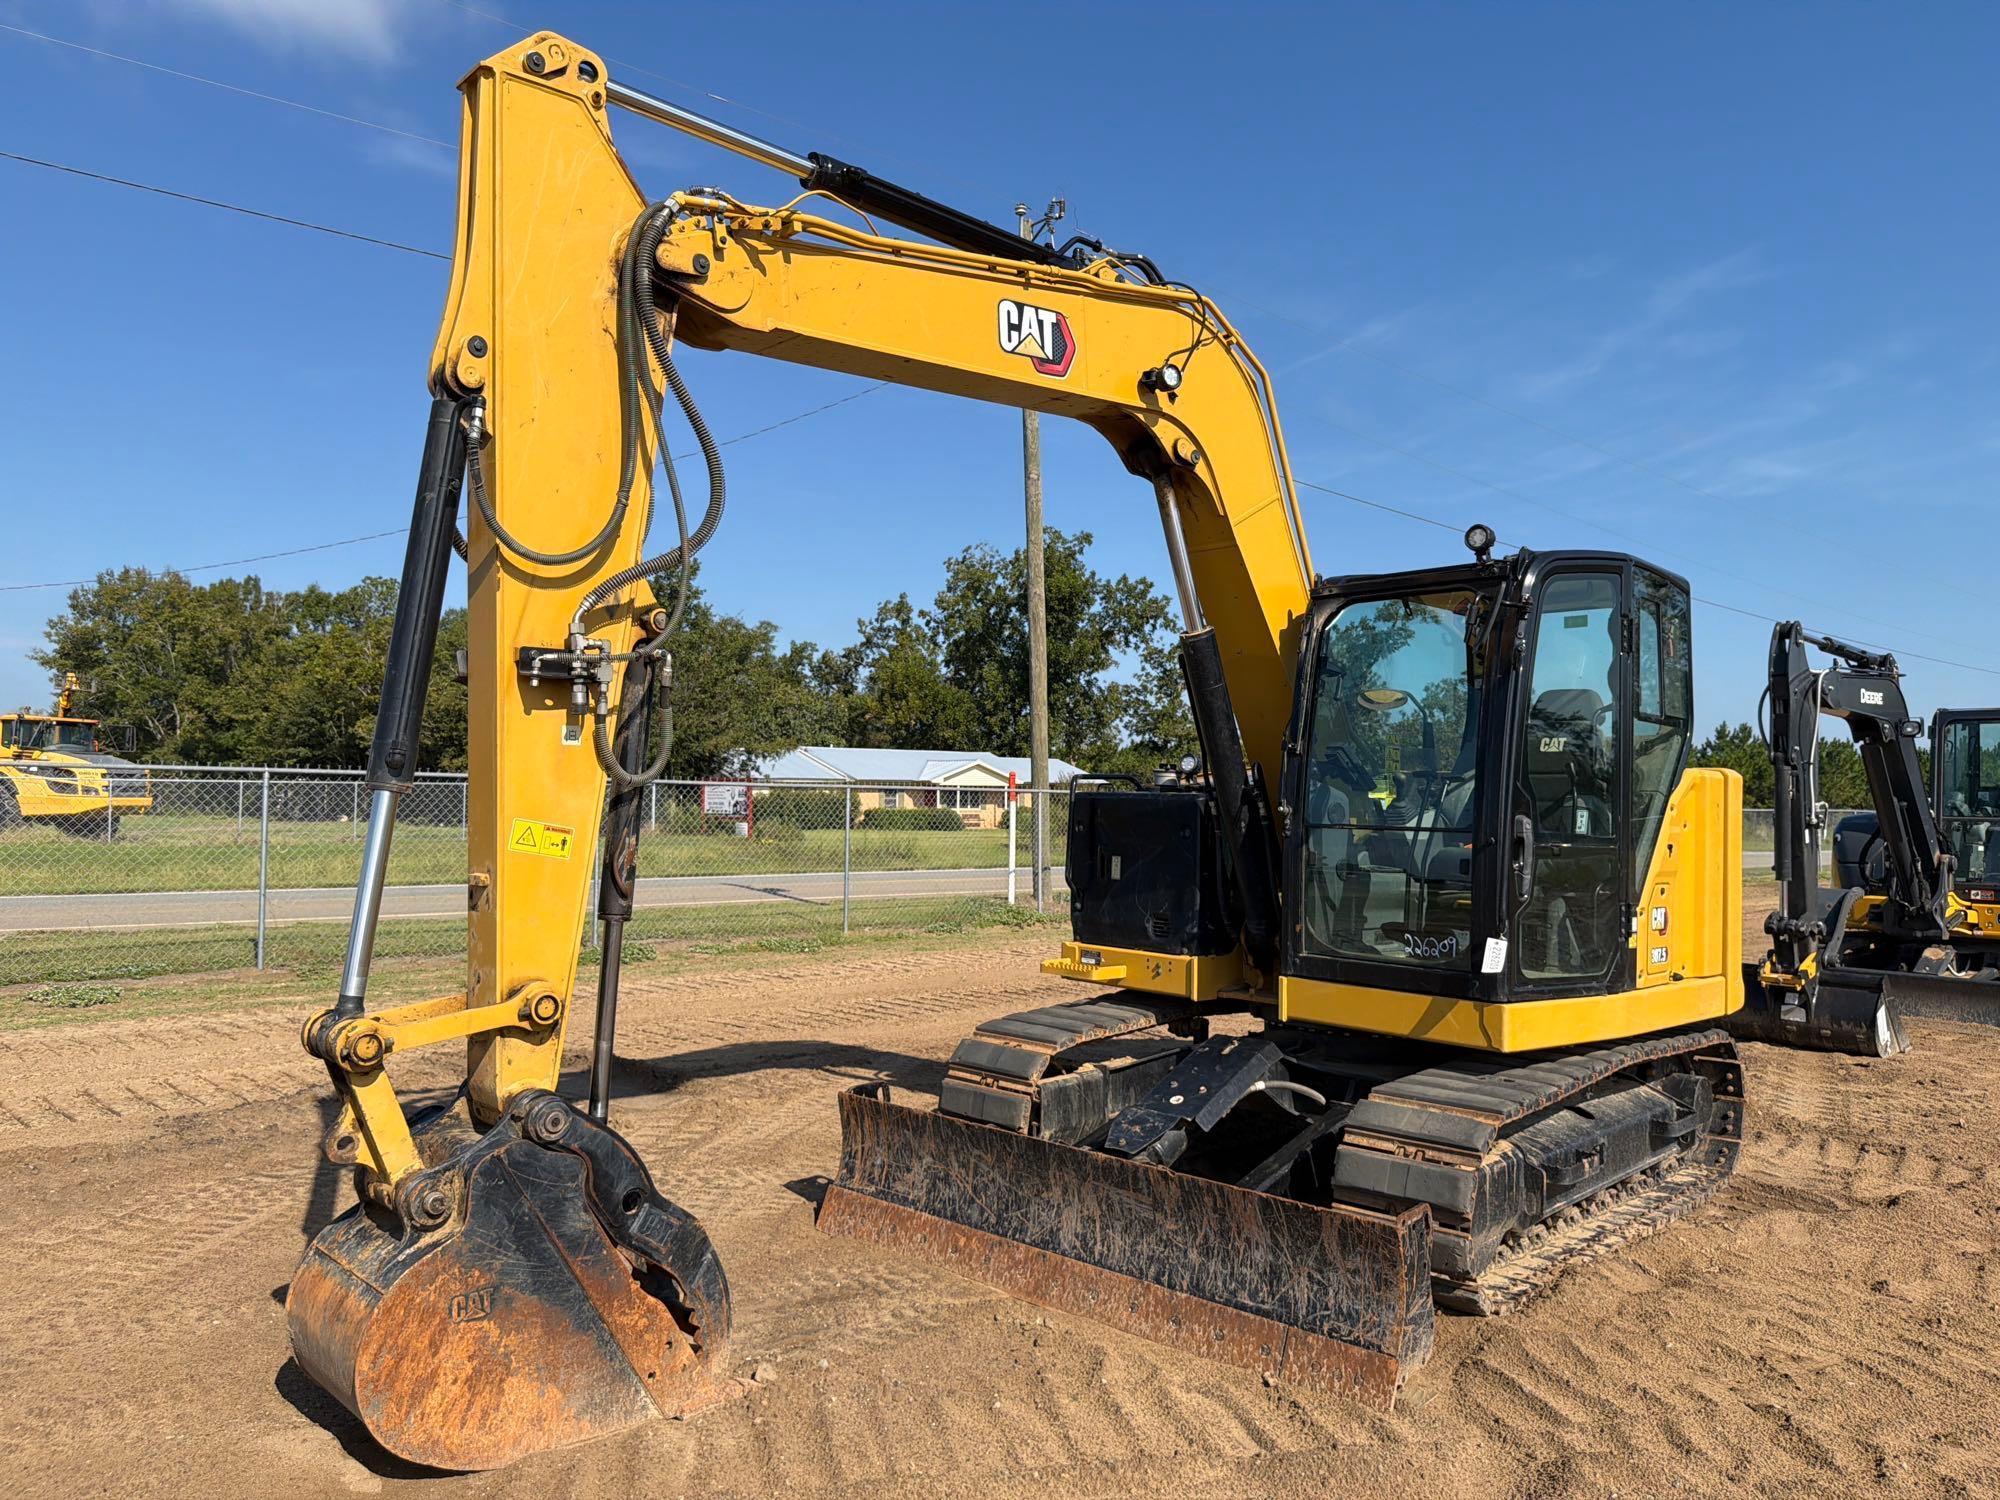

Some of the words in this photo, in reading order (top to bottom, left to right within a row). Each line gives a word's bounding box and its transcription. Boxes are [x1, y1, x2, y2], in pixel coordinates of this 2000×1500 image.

[999, 300, 1057, 360] CAT
[1861, 688, 1884, 705] DEERE
[1540, 737, 1567, 753] CAT
[1652, 907, 1666, 930] CAT
[1404, 933, 1456, 958] 226209
[451, 1288, 495, 1323] CAT
